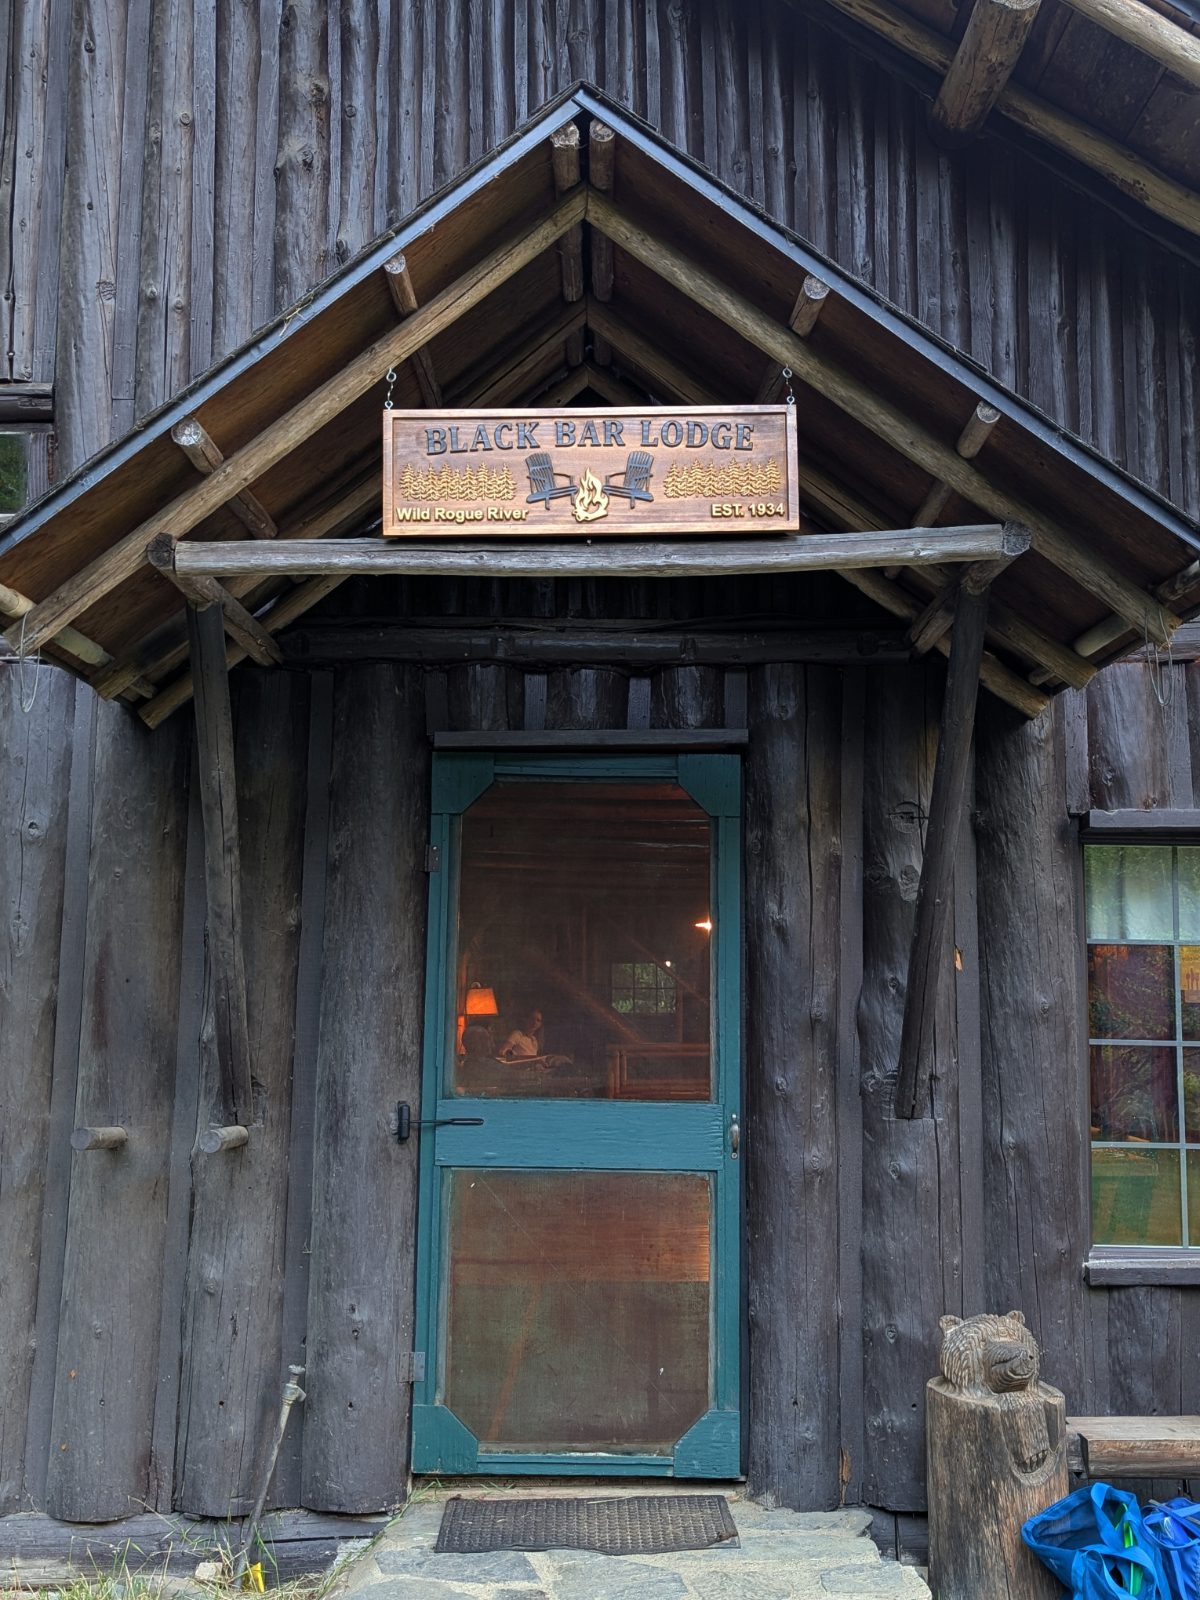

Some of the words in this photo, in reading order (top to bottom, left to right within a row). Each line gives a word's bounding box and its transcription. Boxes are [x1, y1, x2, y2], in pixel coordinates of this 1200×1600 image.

[425, 421, 540, 455] BLACK
[555, 420, 625, 447] BAR
[640, 419, 754, 451] LODGE
[396, 507, 431, 522] Wild
[434, 507, 485, 523] Rogue
[487, 507, 529, 521] River
[711, 503, 744, 517] EST.
[748, 502, 785, 517] 1934
